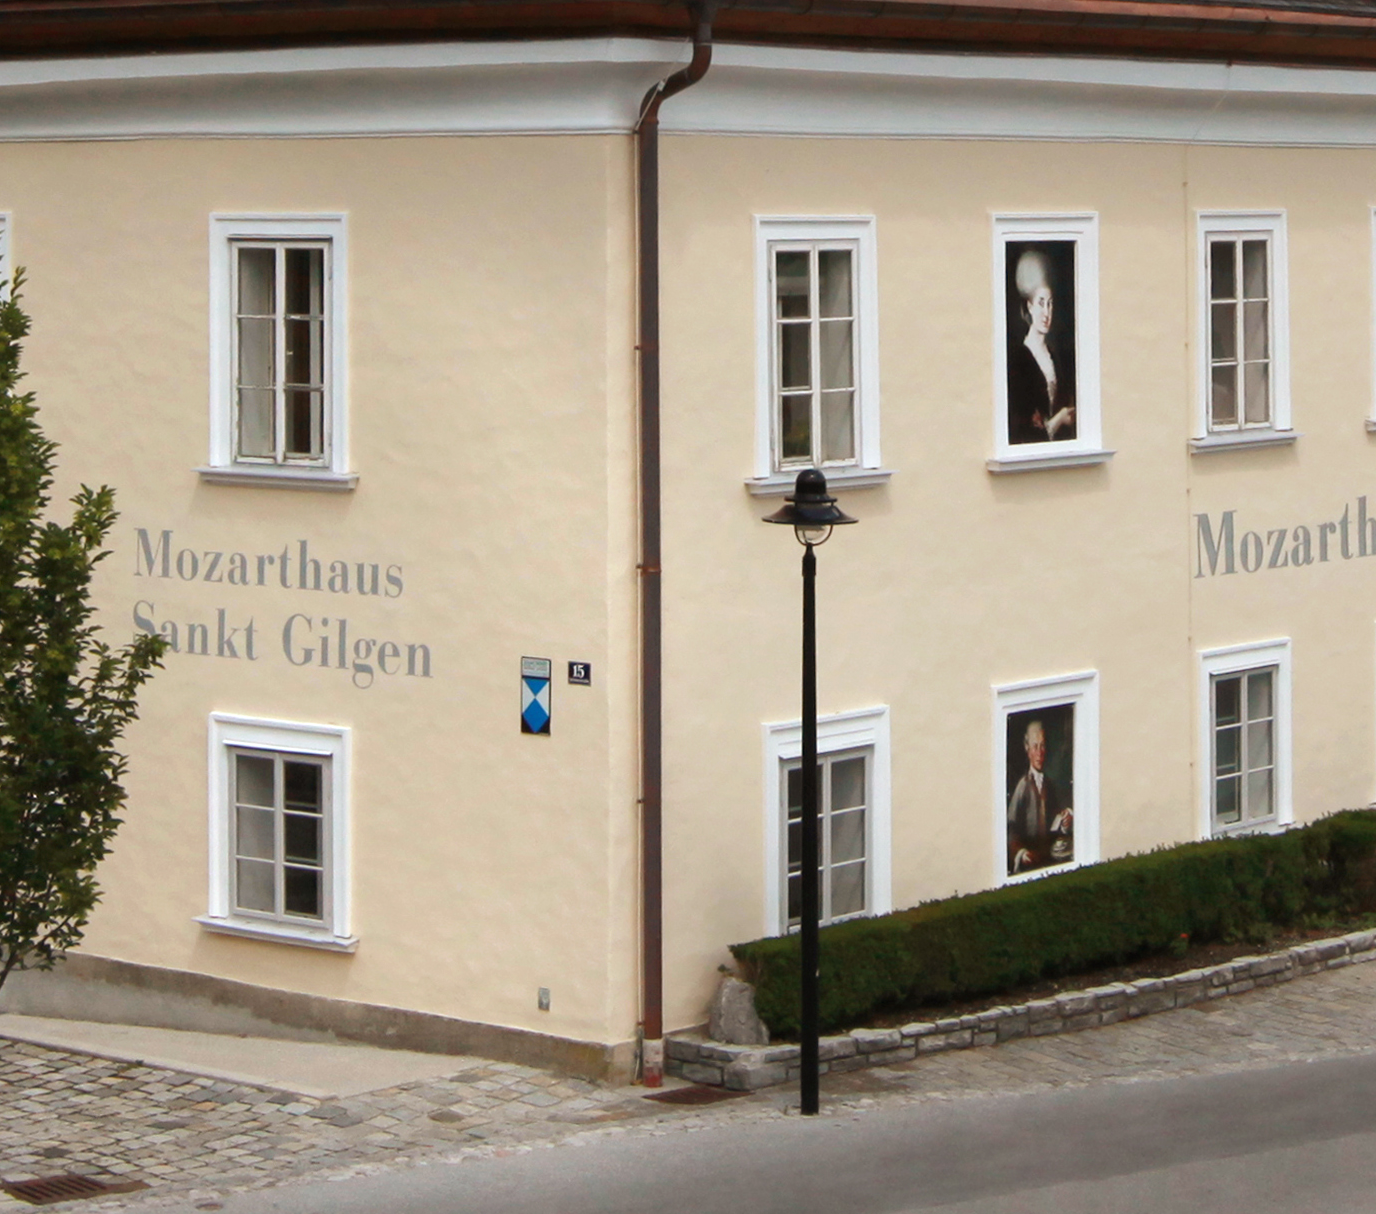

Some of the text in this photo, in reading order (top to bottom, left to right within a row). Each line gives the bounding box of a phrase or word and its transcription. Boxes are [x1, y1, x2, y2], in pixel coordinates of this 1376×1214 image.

[133, 527, 404, 599] Mozarthaus
[132, 599, 434, 690] Sankt Gilgen
[572, 664, 585, 678] 15
